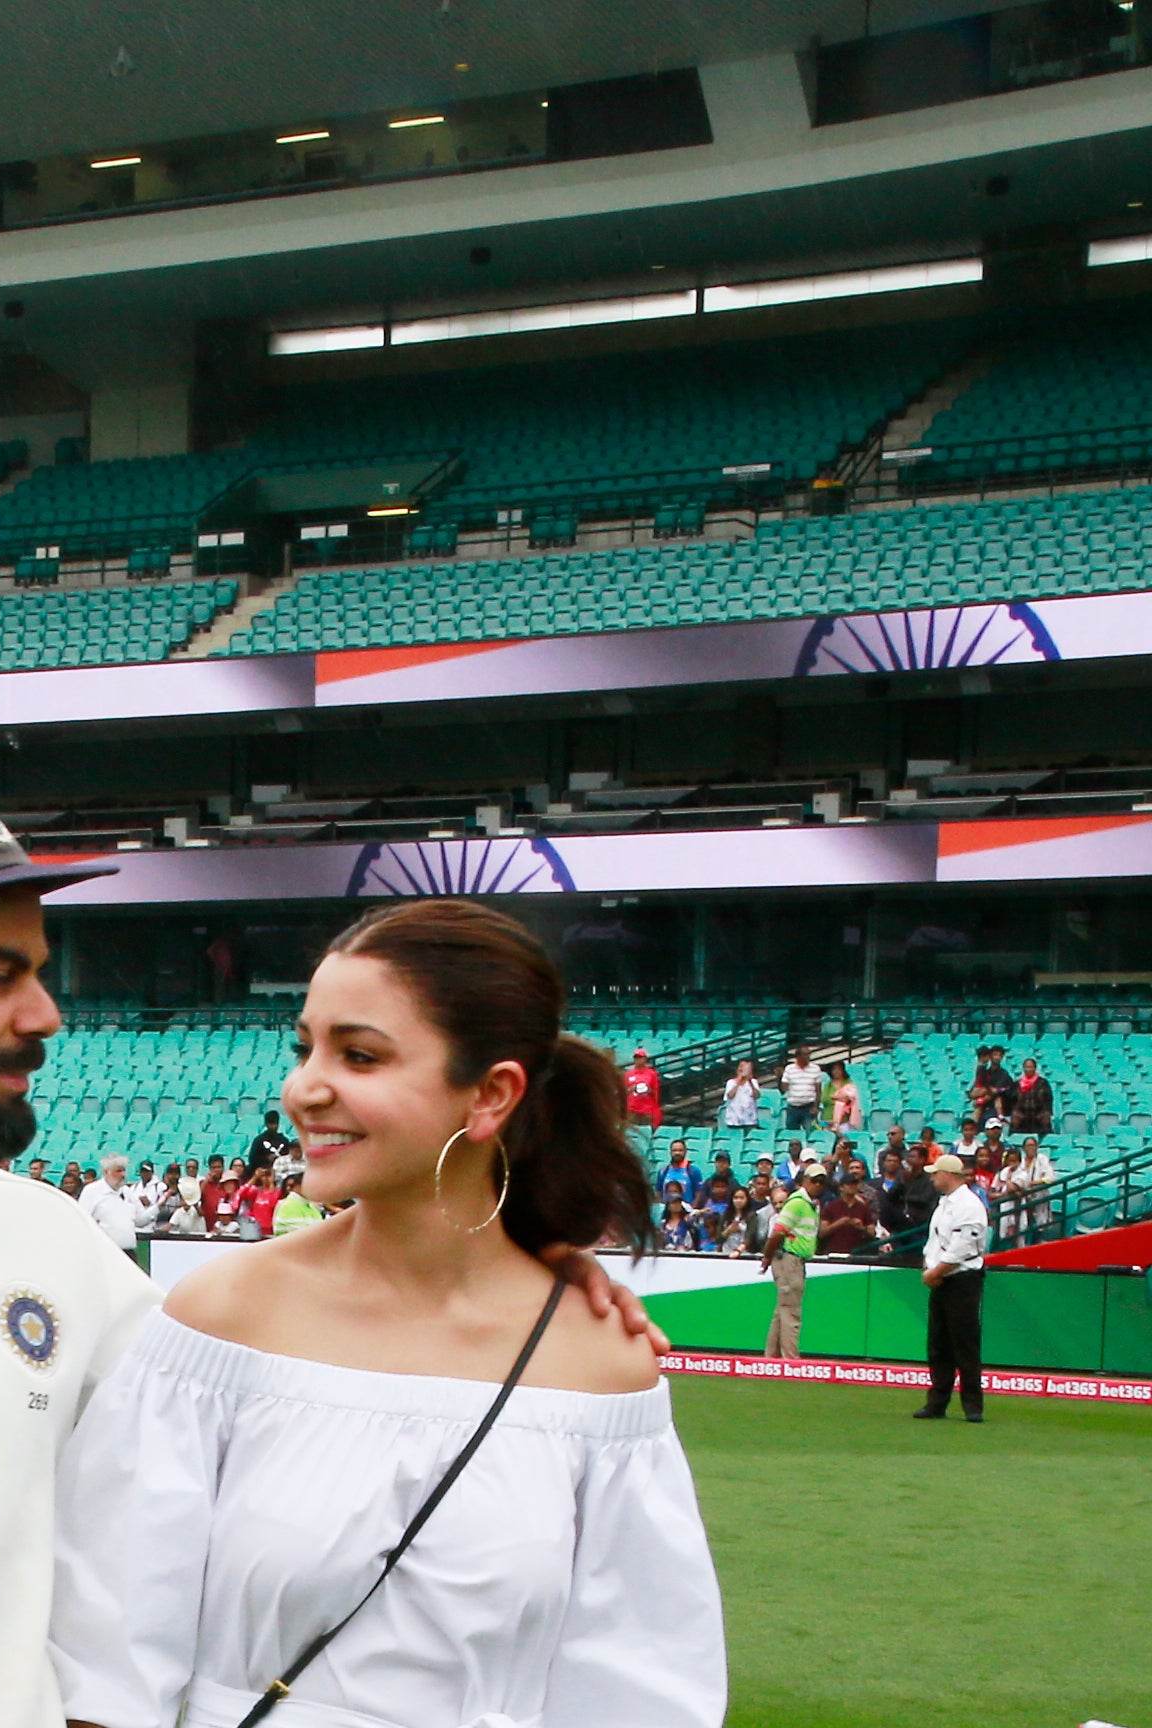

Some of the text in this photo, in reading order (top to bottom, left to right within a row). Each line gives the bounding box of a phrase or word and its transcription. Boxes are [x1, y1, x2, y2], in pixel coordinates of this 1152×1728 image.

[685, 1357, 731, 1373] bet365
[735, 1360, 782, 1376] bet365
[784, 1363, 831, 1379] bet365
[835, 1365, 883, 1382] bet365
[992, 1375, 1043, 1392] bet365
[1046, 1379, 1097, 1396] bet365
[1099, 1382, 1152, 1399] bet365
